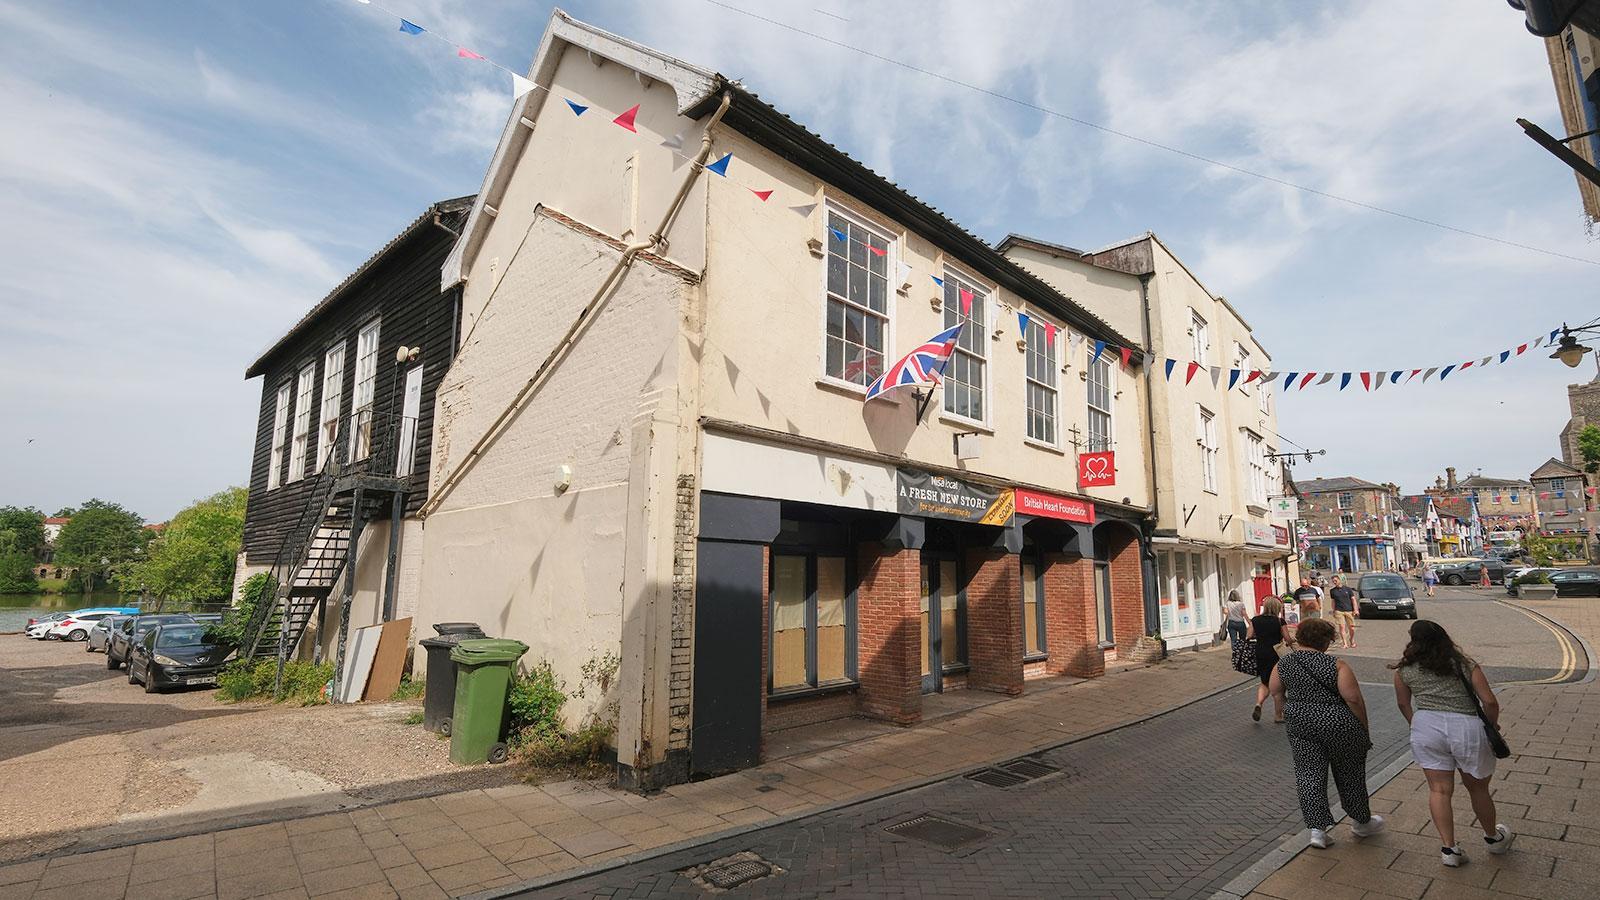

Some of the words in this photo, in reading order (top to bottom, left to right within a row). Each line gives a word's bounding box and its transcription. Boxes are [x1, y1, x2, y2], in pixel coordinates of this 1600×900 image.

[945, 479, 958, 490] local
[900, 485, 907, 497] A
[909, 487, 938, 502] FRESH
[940, 492, 959, 505] NEW
[960, 496, 987, 509] STORE
[1024, 496, 1043, 509] British
[1044, 500, 1058, 512] Heart
[1059, 503, 1086, 516] Foundation
[999, 500, 1014, 521] SOON
